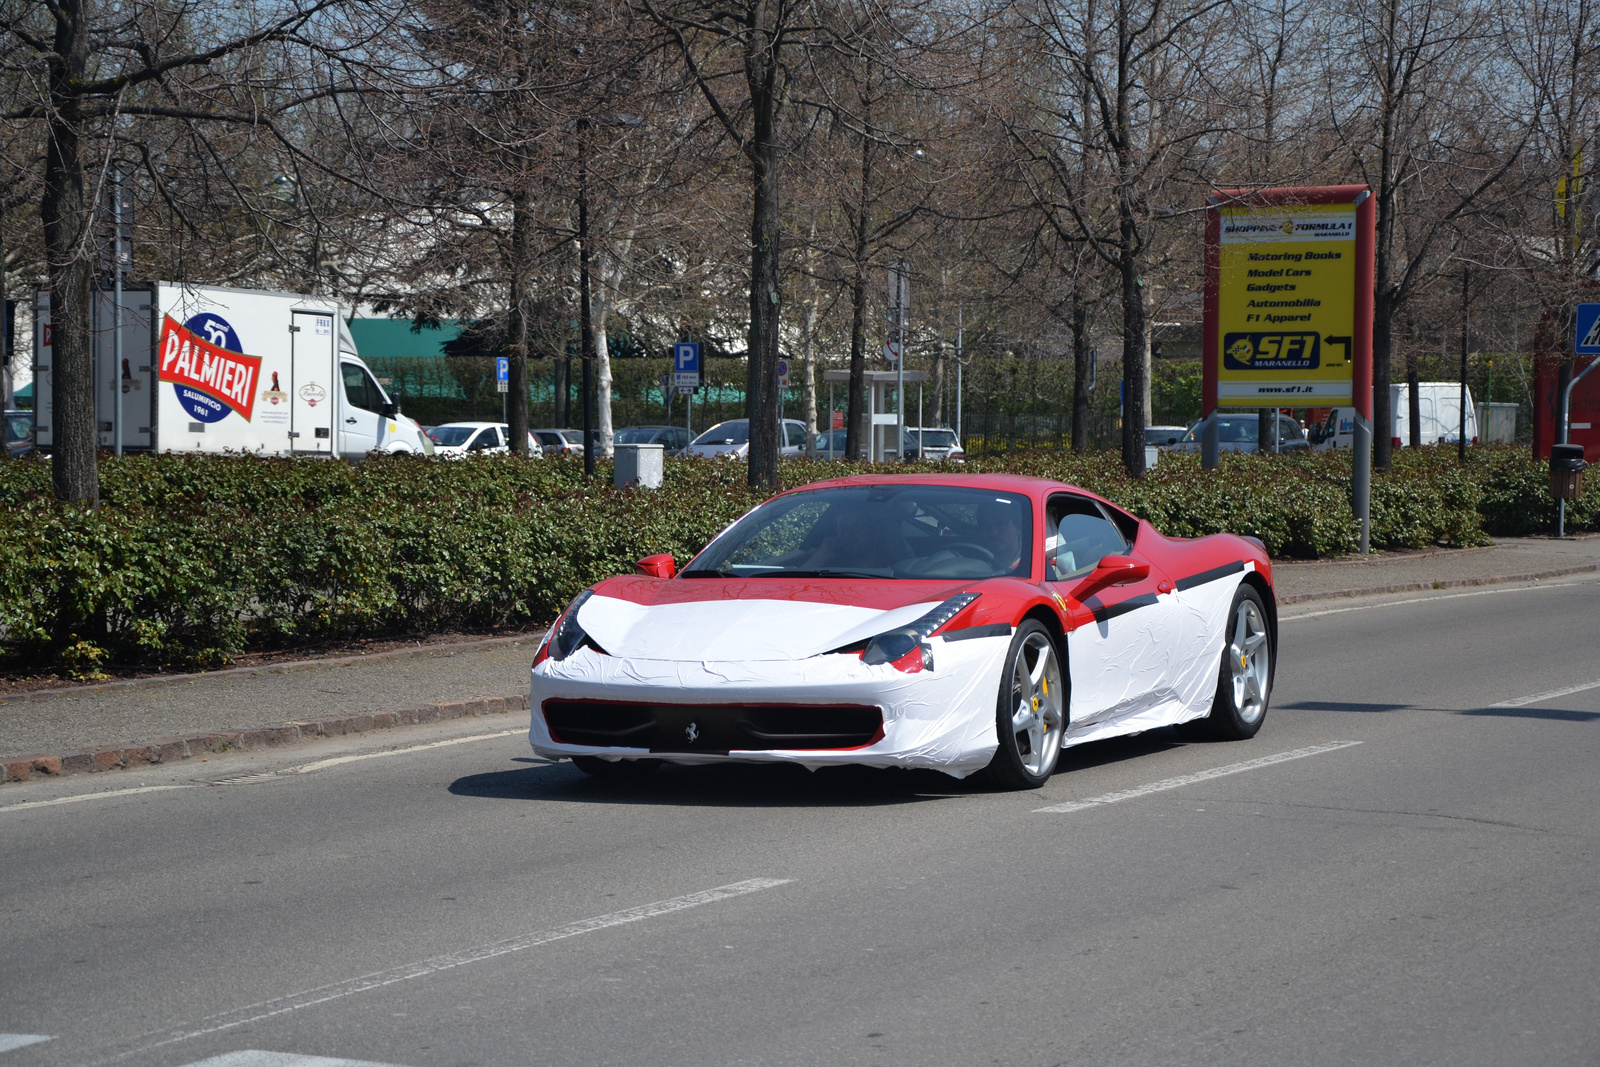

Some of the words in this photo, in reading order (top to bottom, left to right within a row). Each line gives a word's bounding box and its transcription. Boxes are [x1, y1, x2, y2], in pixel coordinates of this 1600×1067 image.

[1295, 222, 1346, 231] FORMULA
[1248, 252, 1302, 262] Motoring
[1304, 251, 1342, 260] Books
[1247, 268, 1284, 277] Model
[1285, 268, 1312, 277] Cars
[1246, 283, 1296, 293] Gadgets
[1246, 298, 1321, 308] Automobilia
[1246, 314, 1260, 322] F1
[1263, 313, 1312, 323] Apparel
[204, 319, 226, 348] 50
[214, 322, 230, 333] anni
[1256, 335, 1316, 359] SF1
[679, 345, 694, 369] P
[162, 328, 254, 407] PALMIERI
[500, 360, 509, 378] P
[183, 389, 221, 411] SALUMIFICIO
[193, 404, 209, 417] 1961
